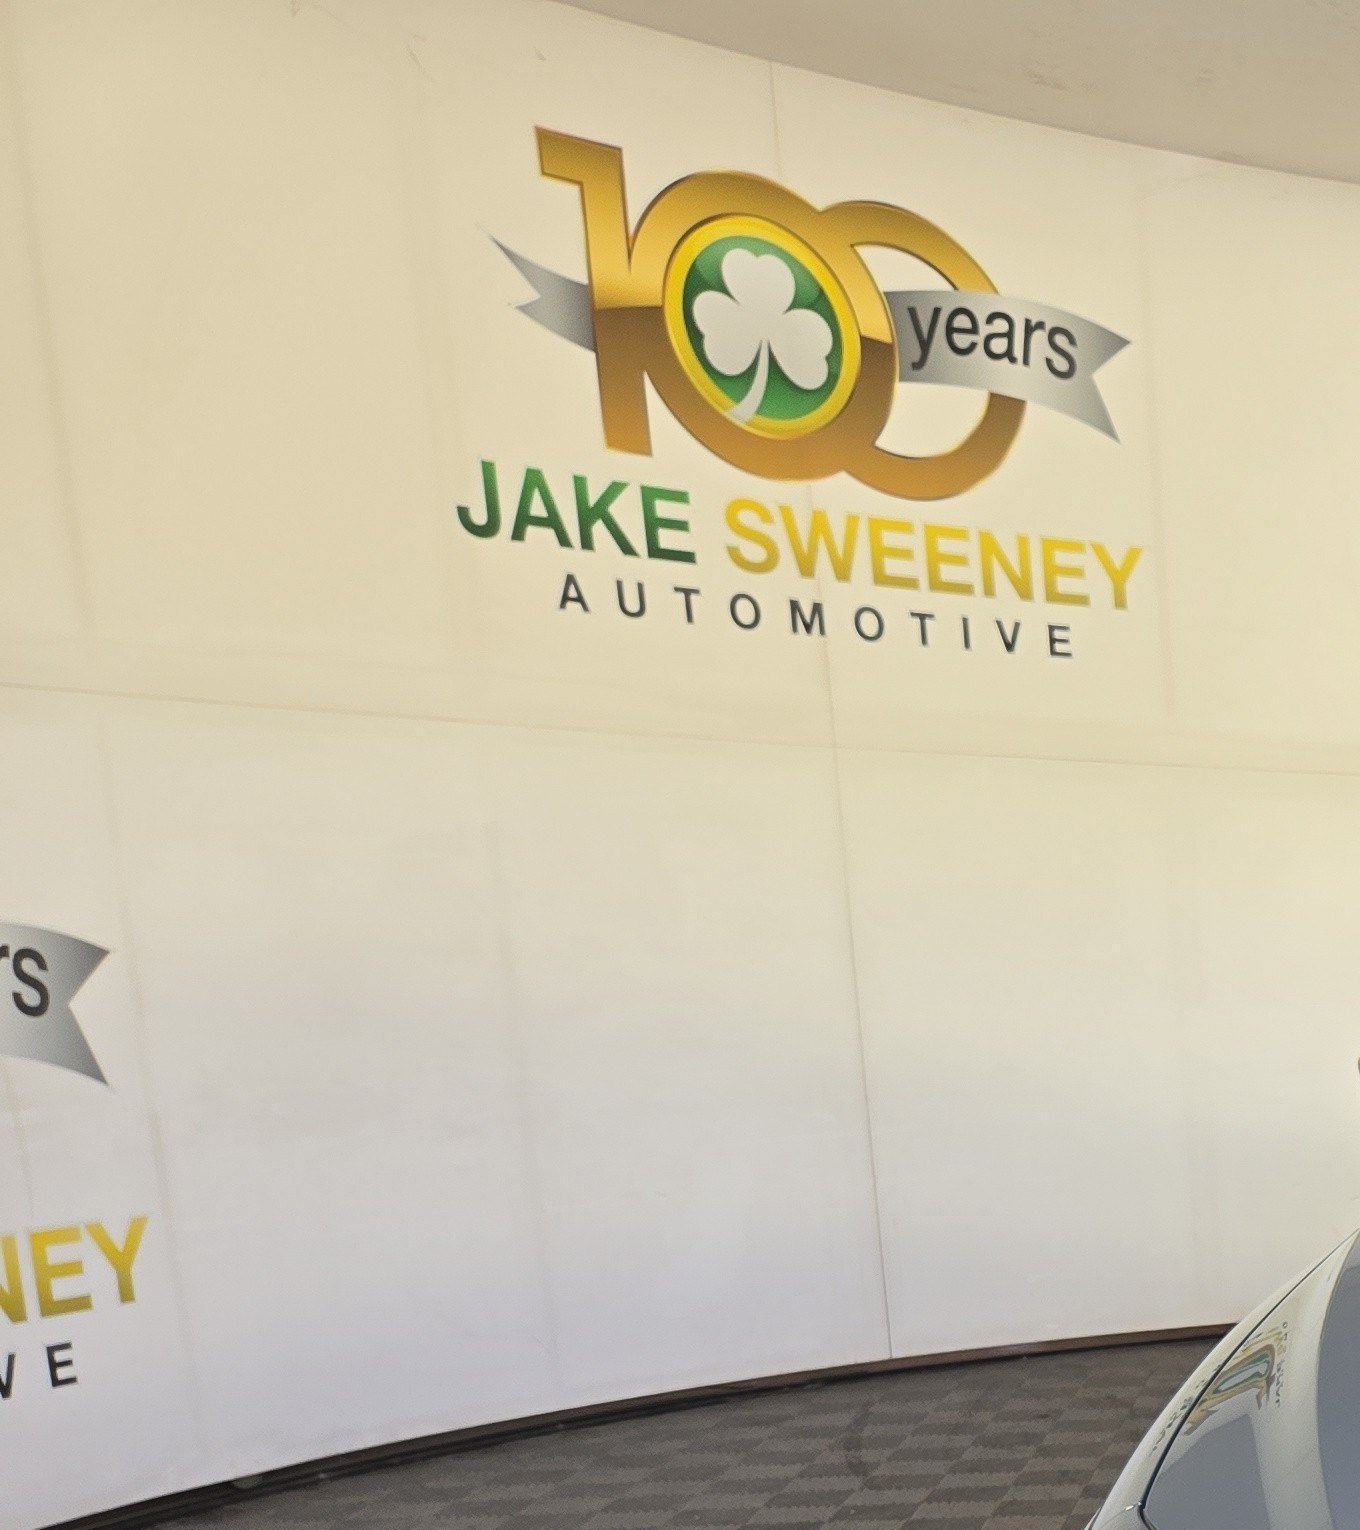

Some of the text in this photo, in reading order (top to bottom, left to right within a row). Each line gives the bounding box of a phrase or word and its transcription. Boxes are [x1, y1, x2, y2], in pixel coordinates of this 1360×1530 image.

[535, 125, 1028, 502] 100
[907, 304, 1079, 382] years
[456, 459, 1143, 611] JAKE SWEENEY
[559, 573, 1074, 658] AUTOMOTIVE
